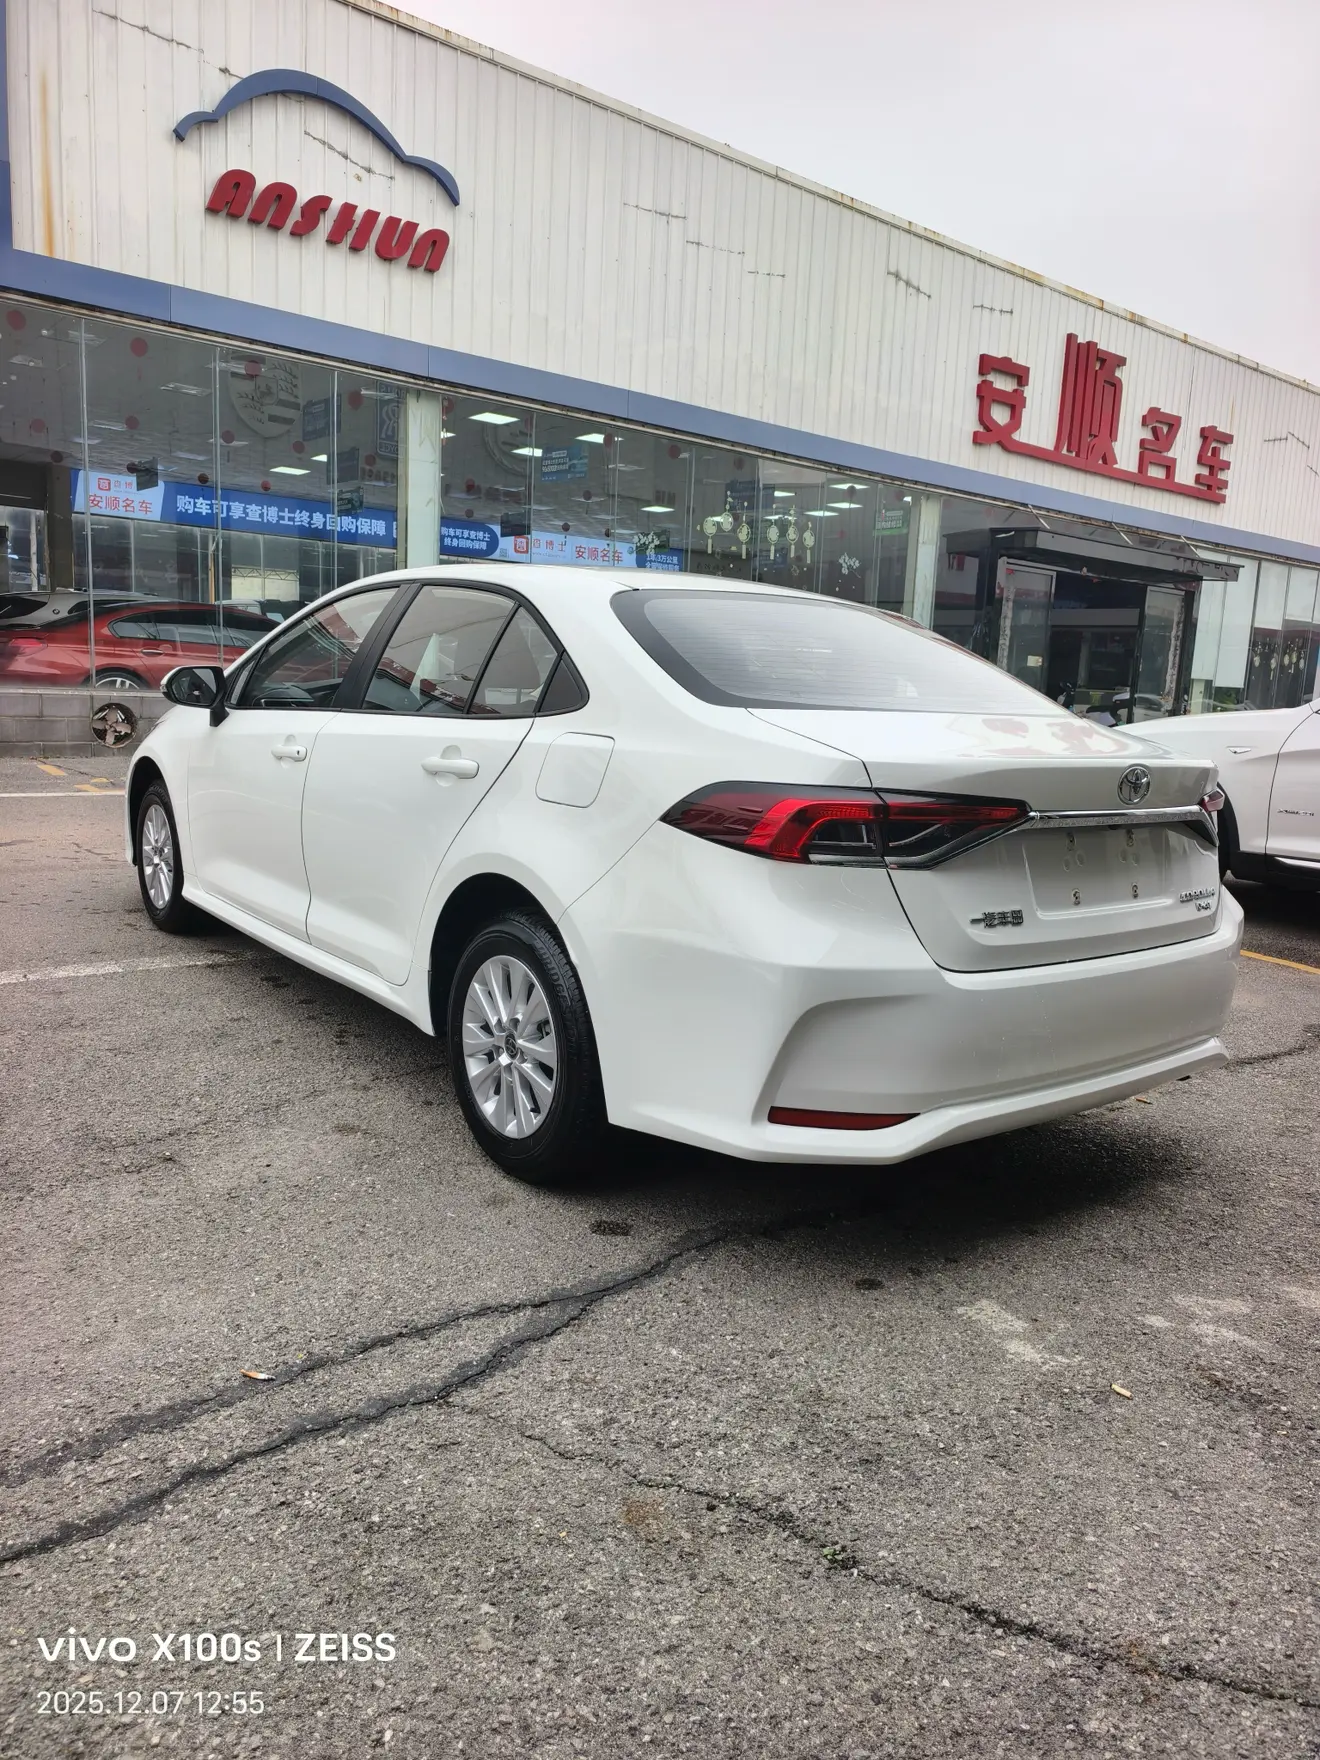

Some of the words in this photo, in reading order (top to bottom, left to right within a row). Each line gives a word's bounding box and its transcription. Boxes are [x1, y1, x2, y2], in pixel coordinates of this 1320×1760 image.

[972, 332, 1234, 504] 安顺名车
[88, 494, 152, 515] 安顺名车
[176, 495, 386, 537] 购车可享查博士终身回购保障
[575, 545, 623, 565] 安顺名车
